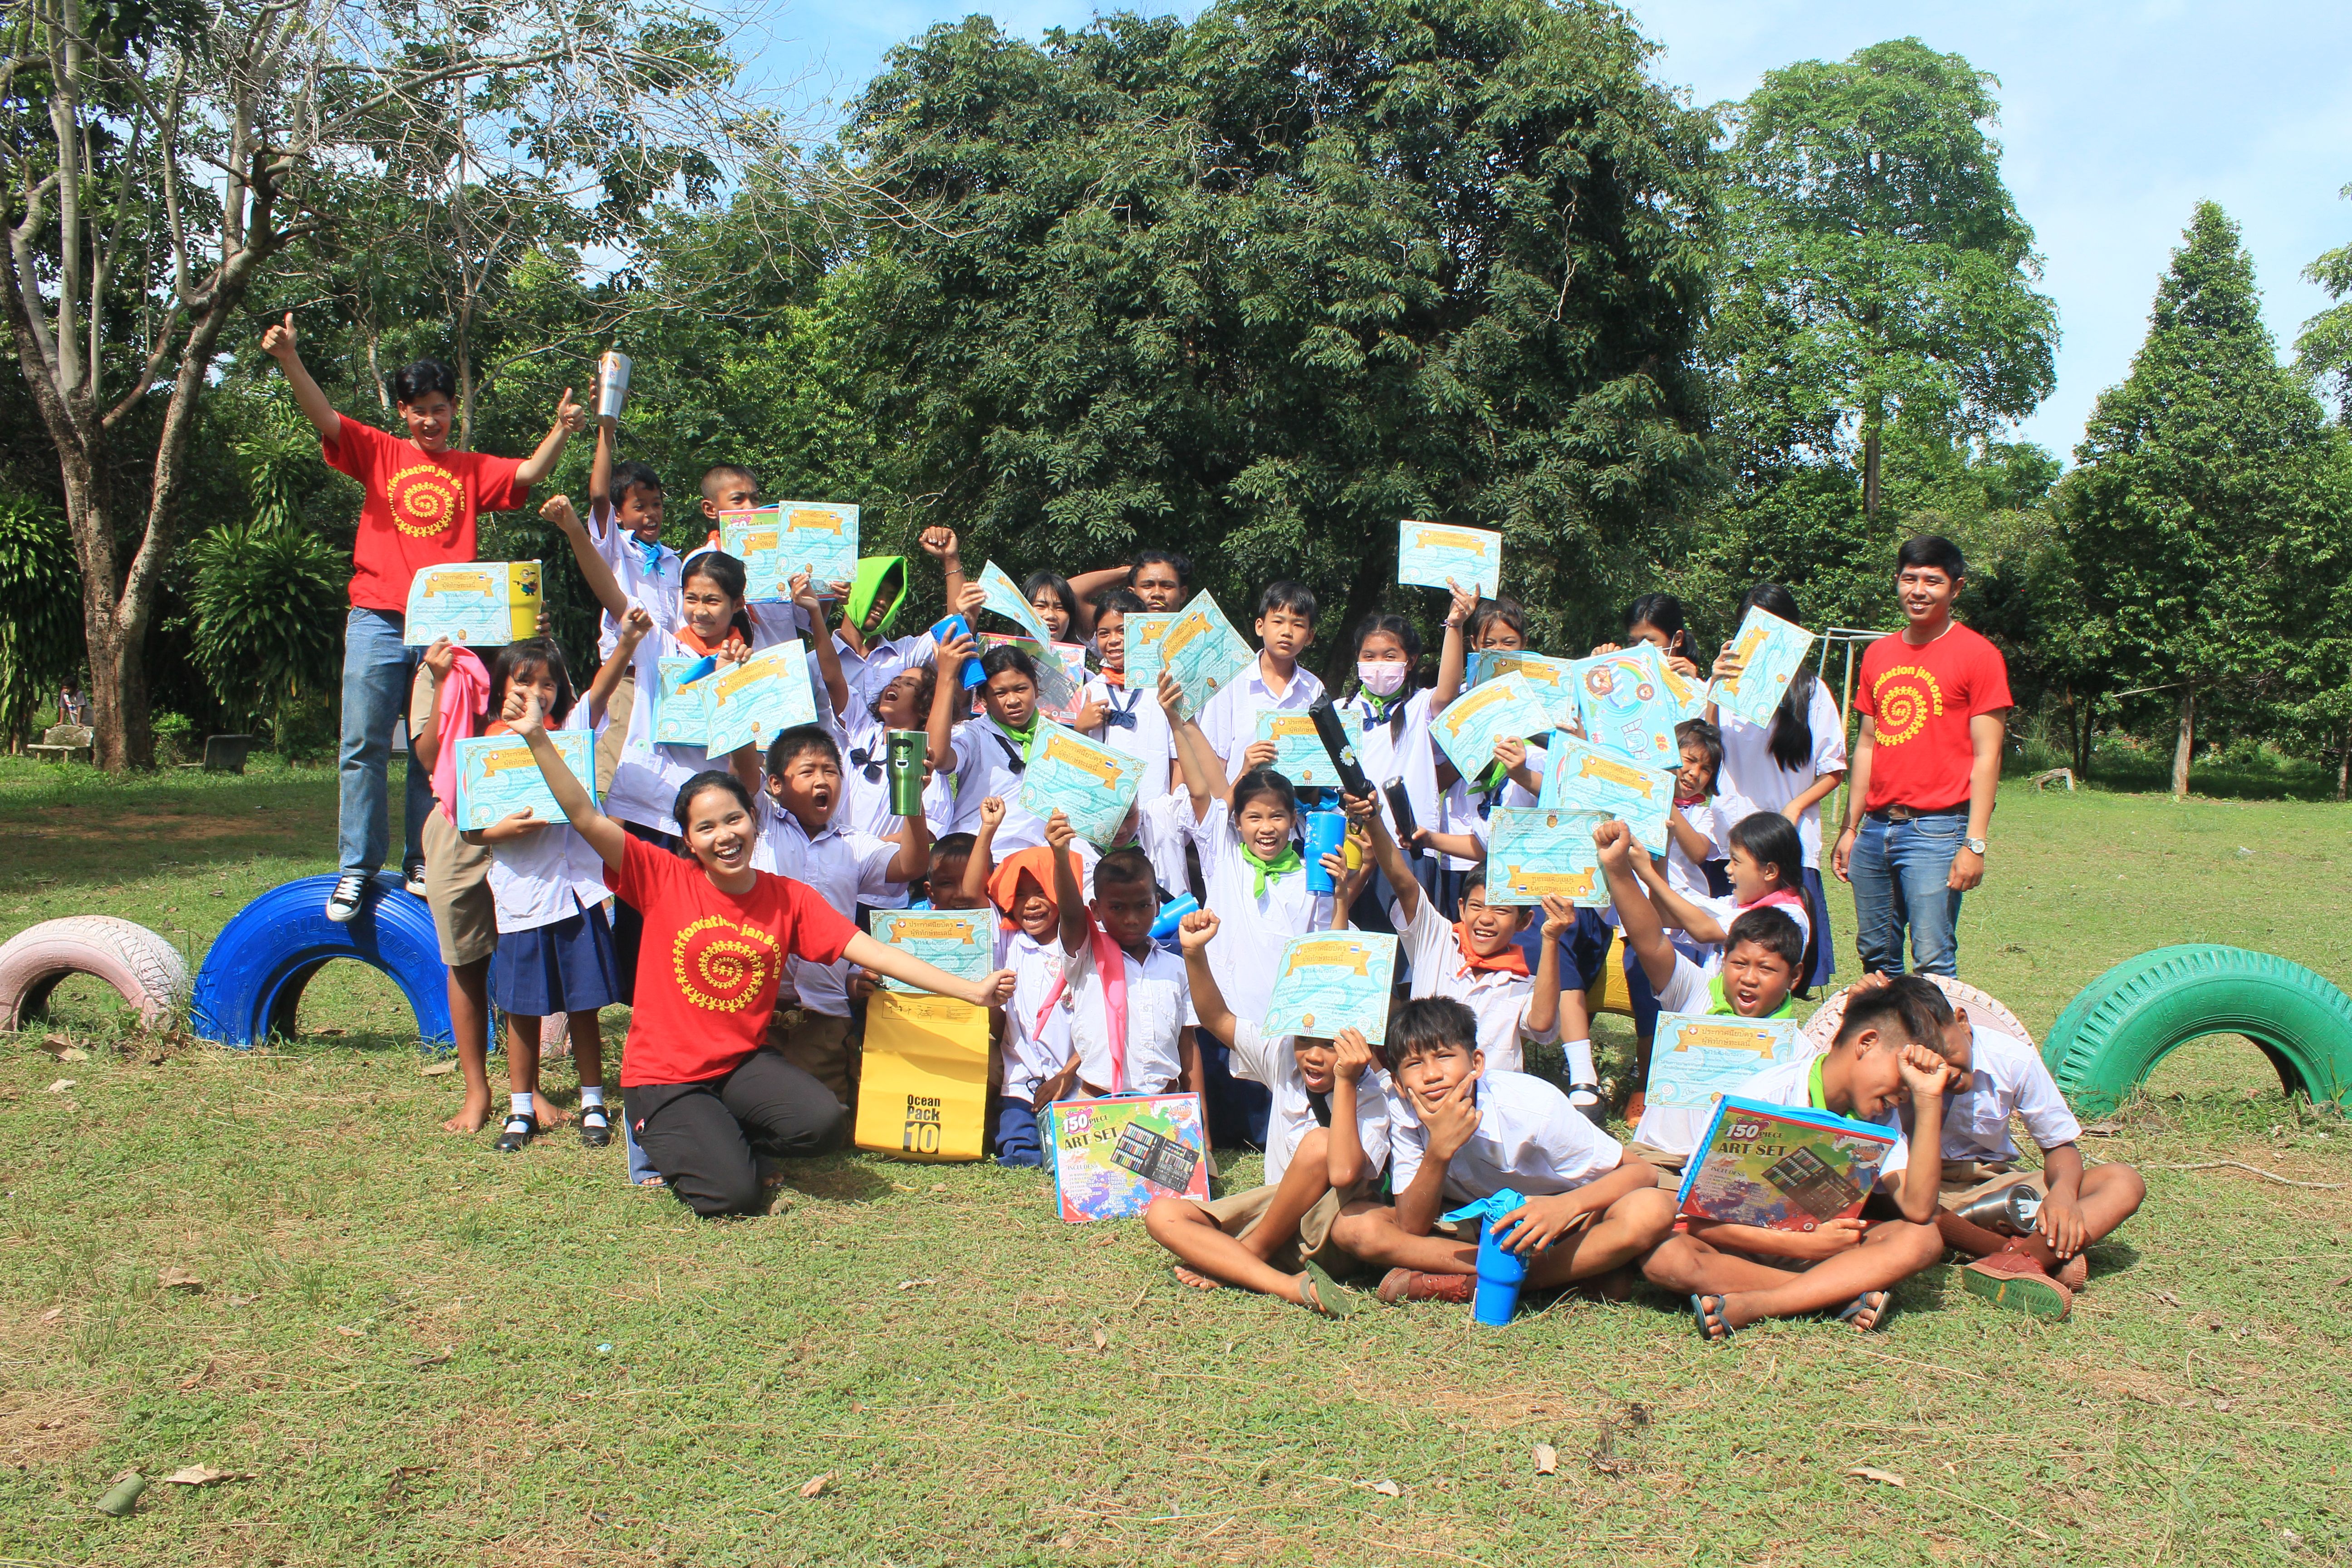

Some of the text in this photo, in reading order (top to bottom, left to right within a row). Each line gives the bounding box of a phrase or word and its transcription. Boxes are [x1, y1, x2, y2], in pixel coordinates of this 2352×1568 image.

[1872, 665, 1915, 698] ondation
[1656, 736, 1668, 750] 86
[1303, 944, 1347, 953] ประกาศนียบัตร
[1701, 1027, 1754, 1038] ประกาศนียบัตร
[907, 1094, 941, 1107] Ocean
[907, 1106, 940, 1121] Pack
[1063, 1113, 1109, 1133] 150 PIECE
[906, 1124, 938, 1153] 10
[1064, 1127, 1118, 1150] ART SET
[1725, 1124, 1783, 1139] 150 PIECE
[1718, 1142, 1788, 1156] ART SET
